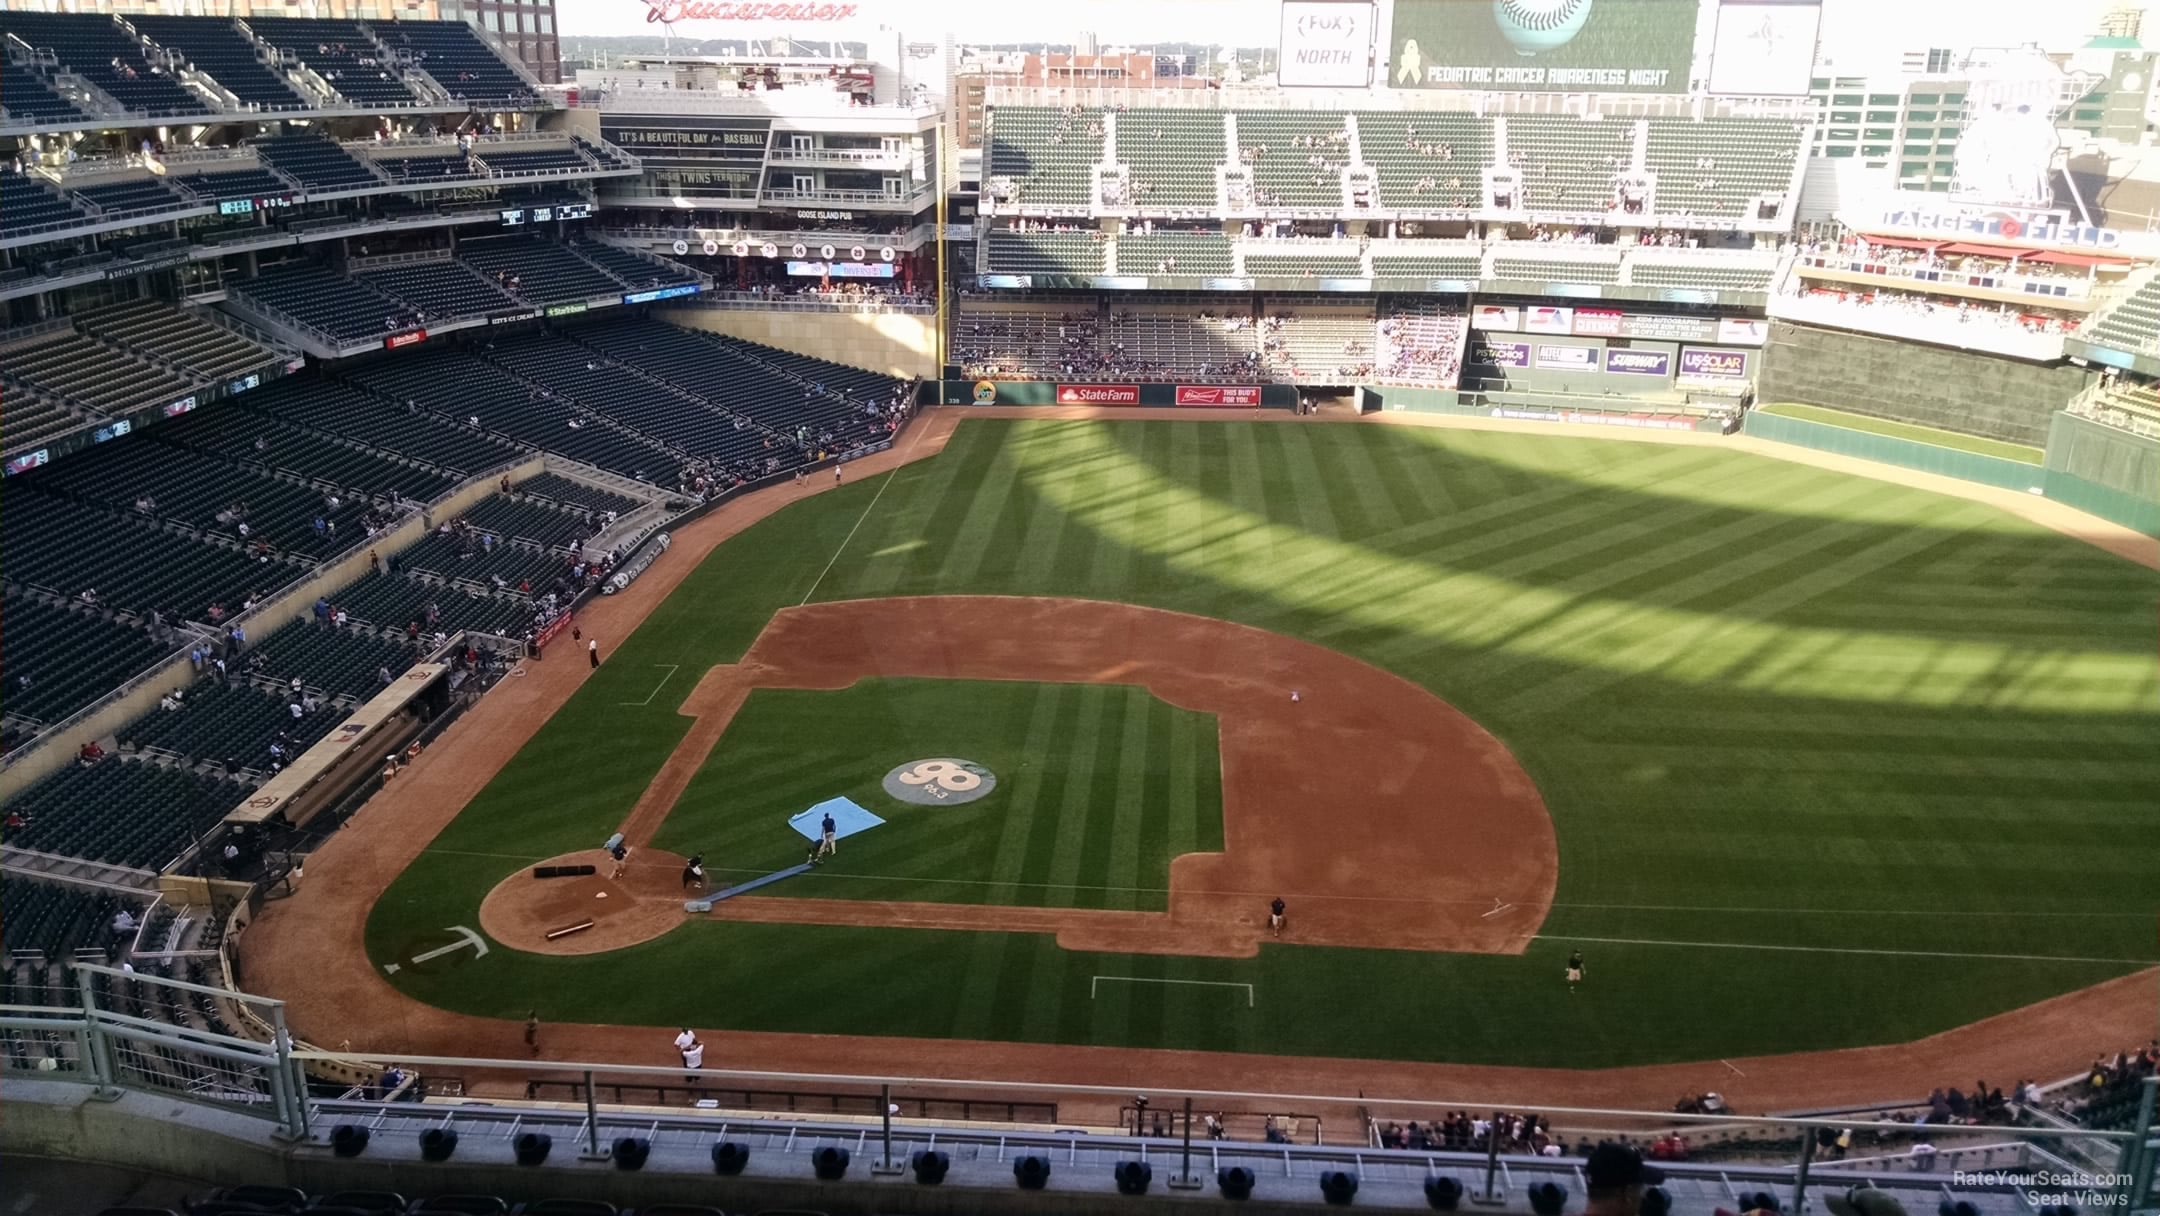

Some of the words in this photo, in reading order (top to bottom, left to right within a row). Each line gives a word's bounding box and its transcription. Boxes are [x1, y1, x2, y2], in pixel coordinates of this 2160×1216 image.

[1309, 15, 1342, 30] FOX
[1295, 48, 1352, 64] NORTH
[1427, 66, 1493, 82] PEDIATRIC
[1495, 67, 1545, 84] CANCER
[1548, 68, 1625, 85] AWARENESS
[1628, 70, 1669, 86] NIGHT
[619, 132, 637, 142] IT'S
[639, 133, 645, 142] A
[647, 132, 692, 143] BEAUTIFUL
[693, 133, 708, 143] DAY
[724, 134, 764, 145] BASEBALL
[656, 171, 672, 181] THIS
[681, 172, 711, 184] TWINS
[712, 173, 750, 183] TERRITORY
[797, 210, 816, 219] GOOSE
[817, 211, 839, 220] ISLAND
[840, 212, 852, 220] PUB
[1883, 211, 1999, 234] TARGET
[2026, 222, 2121, 249] FIELD
[114, 268, 133, 278] DELTA
[508, 315, 516, 323] ICE
[517, 312, 535, 321] CREAM
[1475, 349, 1524, 360] PISTACHIOS
[1608, 354, 1666, 368] SUBWAY
[1223, 389, 1237, 397] THIS
[1238, 389, 1256, 397] BUD'S
[1222, 396, 1235, 404] FOR
